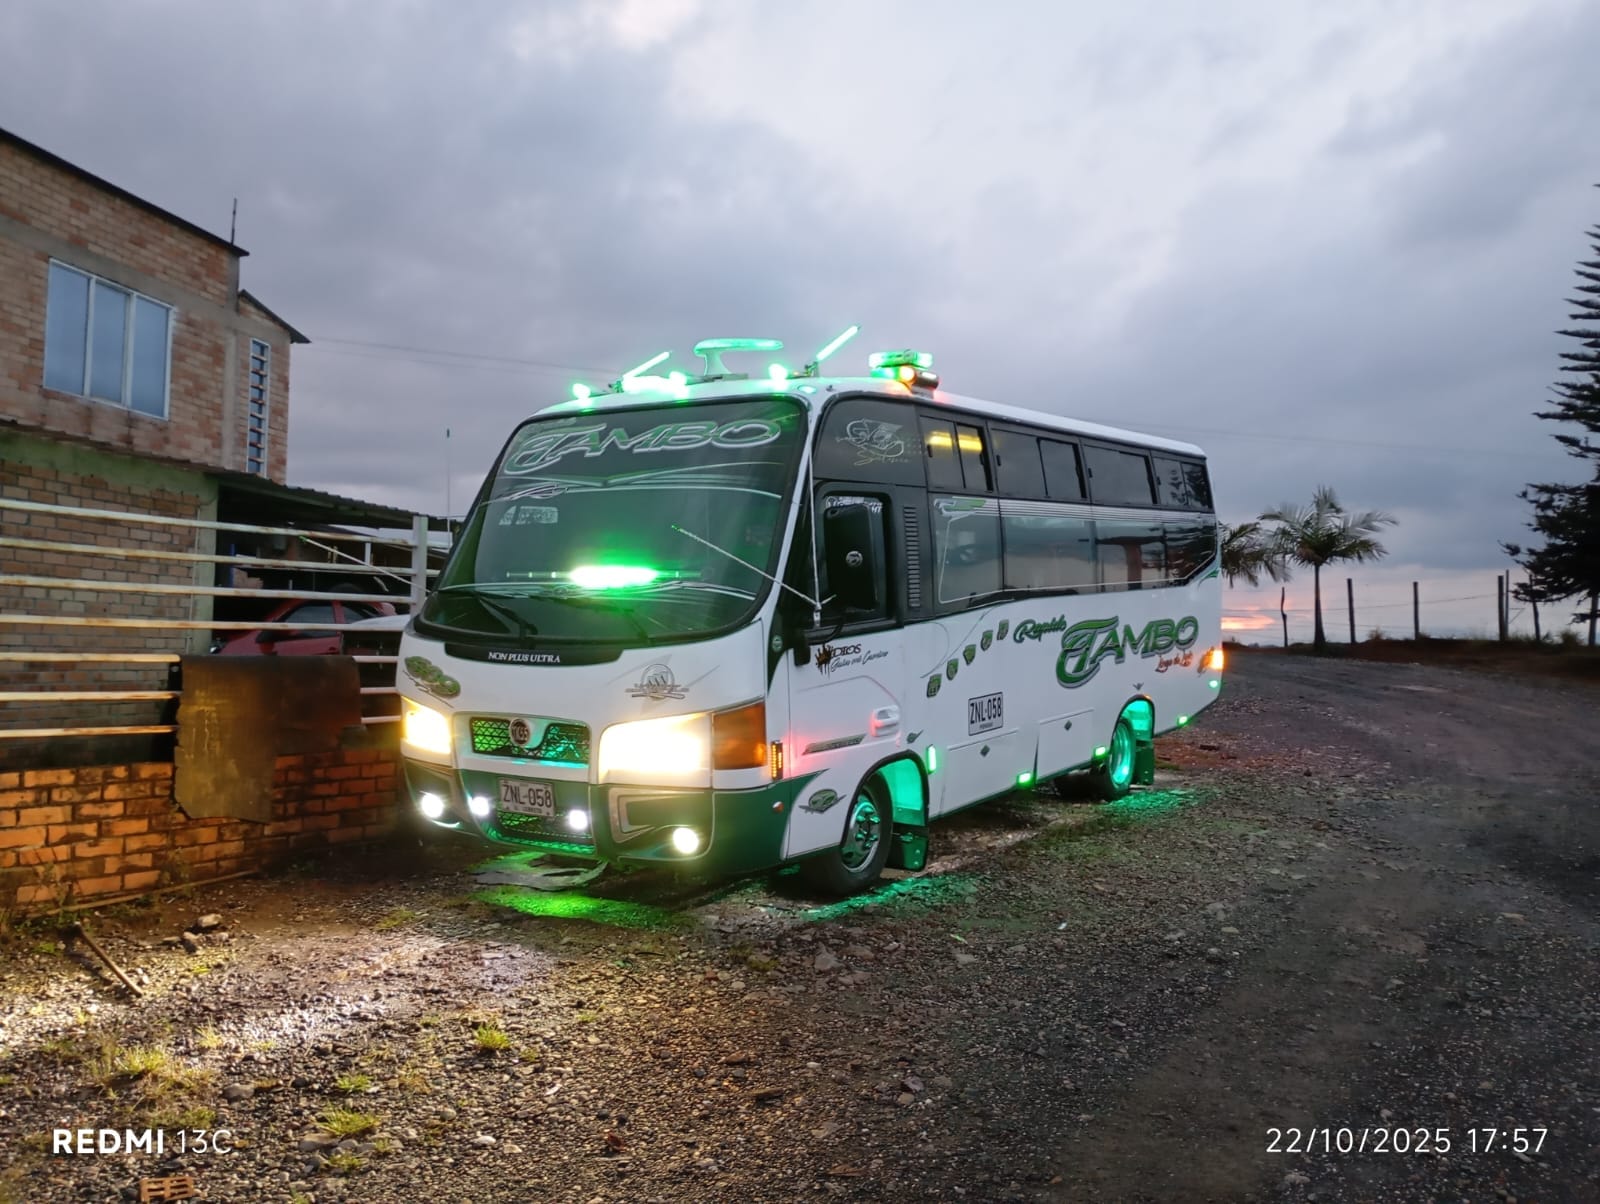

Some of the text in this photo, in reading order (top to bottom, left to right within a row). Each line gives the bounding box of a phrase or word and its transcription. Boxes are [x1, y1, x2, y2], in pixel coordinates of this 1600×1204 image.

[488, 652, 560, 663] NON PLUS ULTRA
[503, 783, 552, 808] ZNL-058
